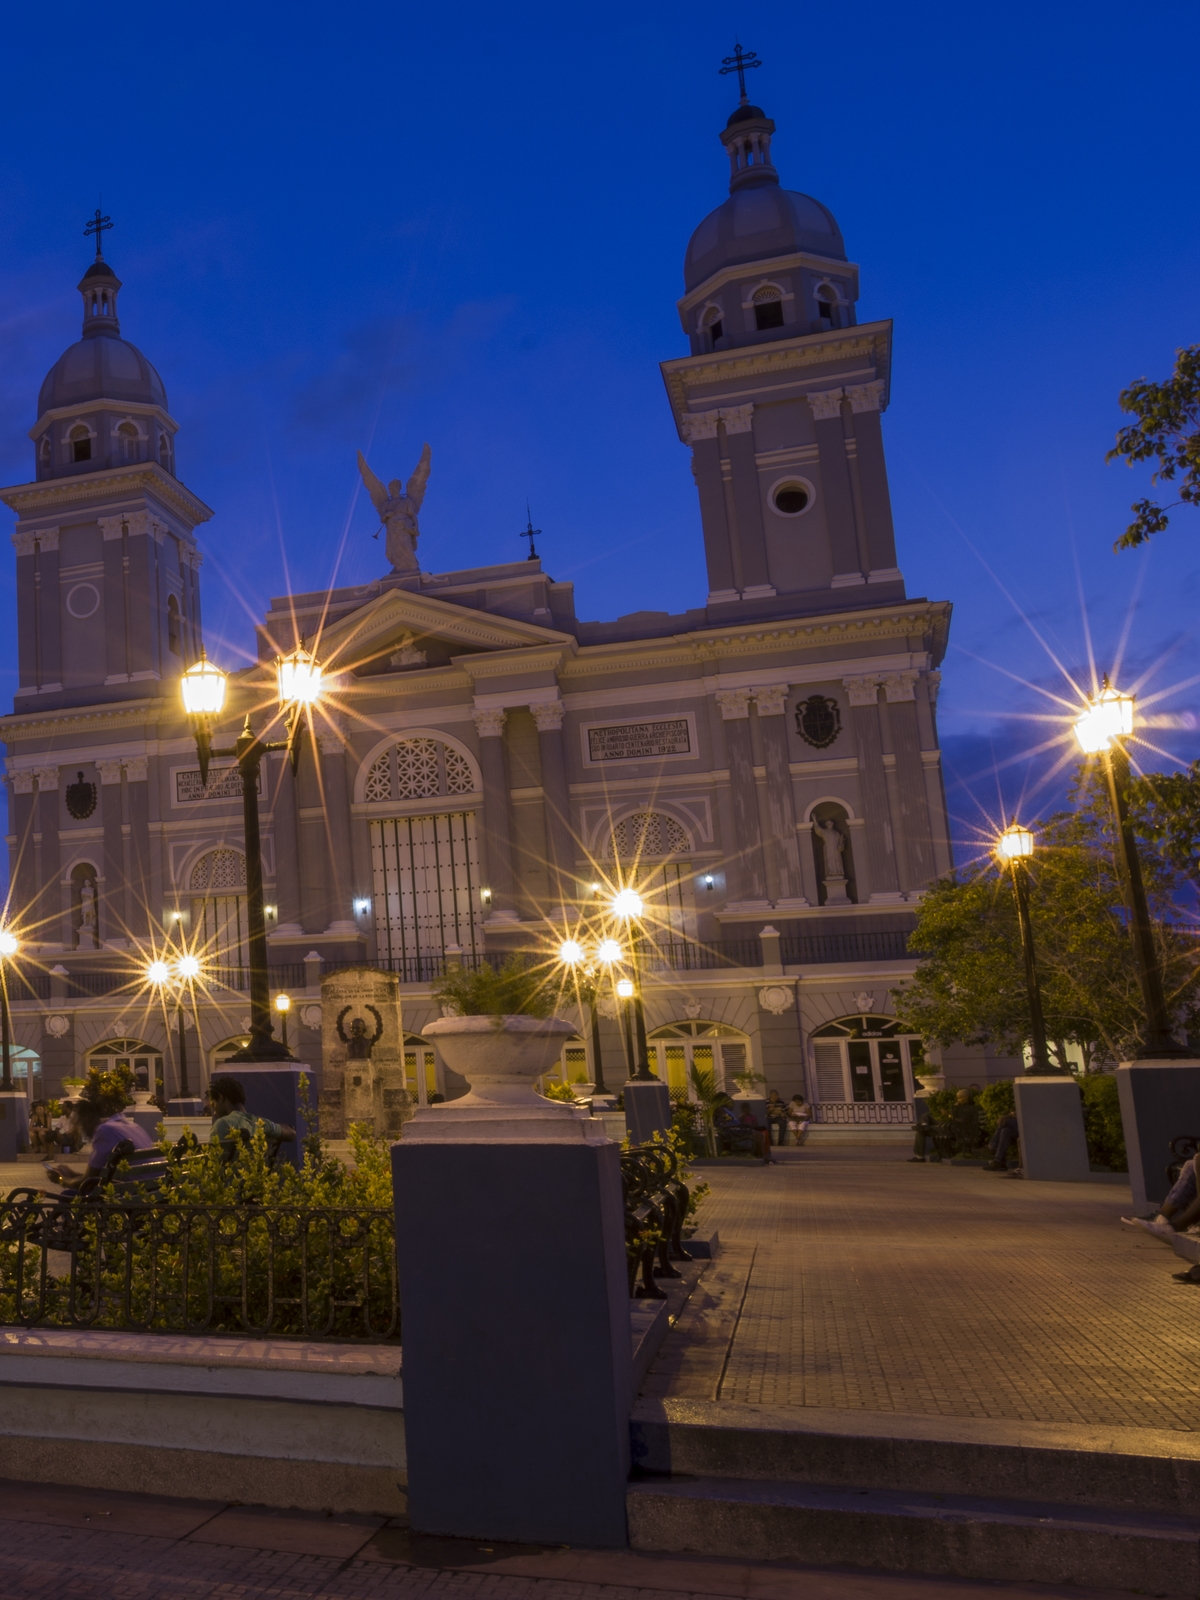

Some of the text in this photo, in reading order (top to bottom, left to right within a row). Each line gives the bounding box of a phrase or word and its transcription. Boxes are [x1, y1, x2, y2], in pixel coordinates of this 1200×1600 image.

[594, 722, 683, 737] METROPOLITANA ECCLESIA
[590, 736, 606, 745] FELICE
[606, 742, 624, 750] QUARTO
[625, 739, 654, 749] CENTENARIO
[604, 745, 676, 758] ANNO DOMINI 1922
